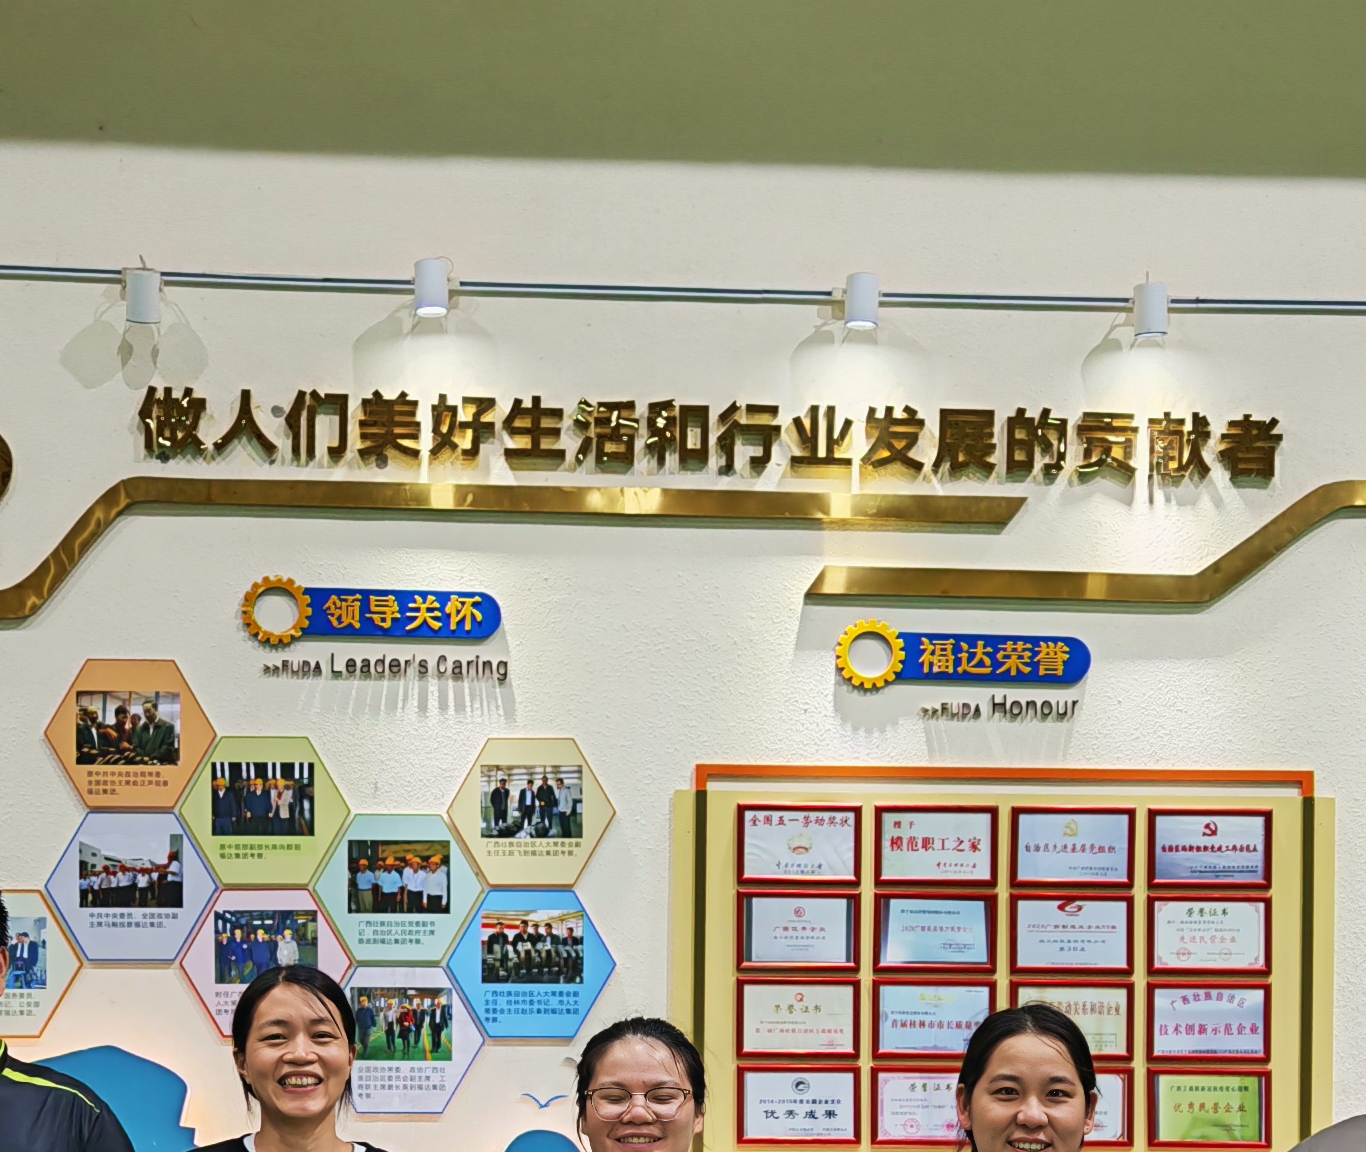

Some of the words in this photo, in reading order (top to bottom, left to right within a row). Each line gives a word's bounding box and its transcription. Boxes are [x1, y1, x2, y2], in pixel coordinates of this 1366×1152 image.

[138, 384, 1284, 479] 做人们美好生活和行业发展的贡献者
[322, 593, 483, 633] 领导关怀
[281, 658, 322, 676] FUDA
[330, 652, 430, 678] Leader's
[436, 653, 509, 682] Caring
[919, 637, 1071, 678] 福达荣誉
[940, 701, 981, 720] FUDA
[991, 694, 1080, 721] Honour
[748, 814, 853, 828] 全国五一劳动奖状
[888, 835, 982, 853] 模范职工之家
[1158, 1022, 1261, 1037] 技术创新示范企业
[762, 1108, 839, 1121] 优秀成果
